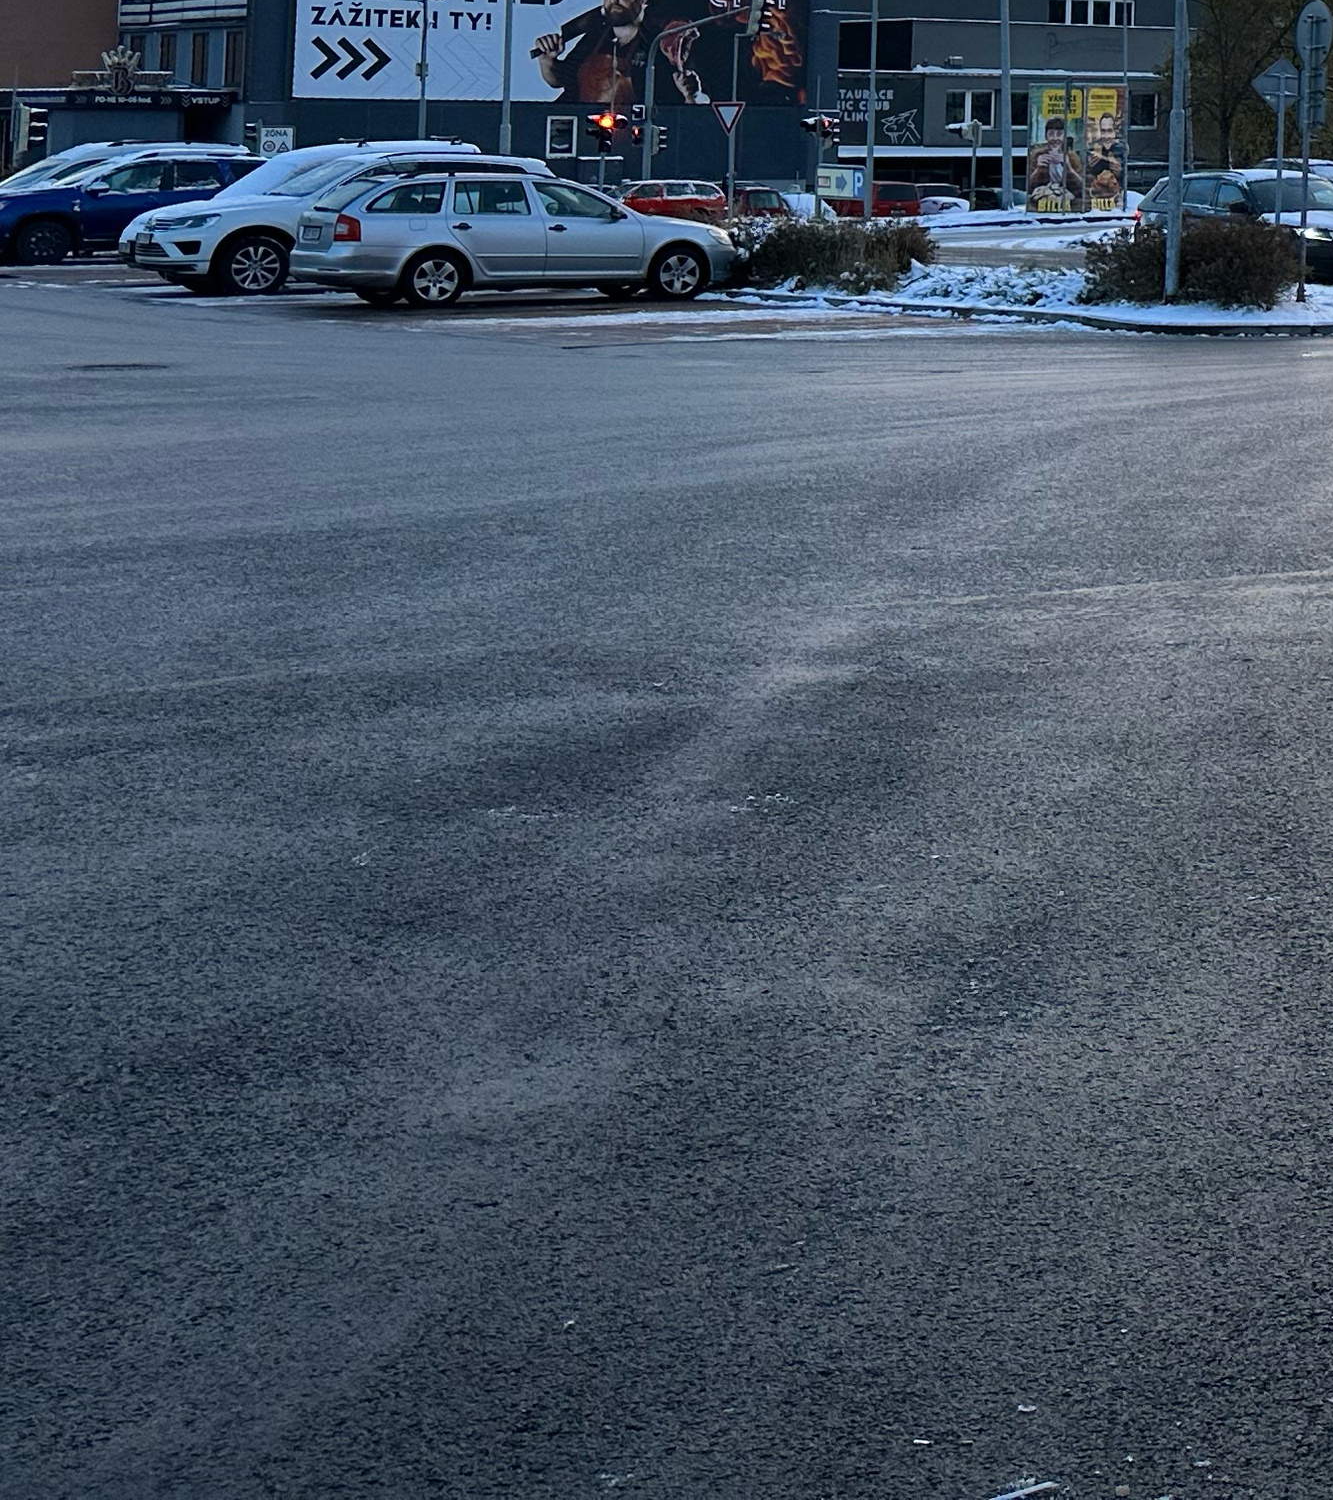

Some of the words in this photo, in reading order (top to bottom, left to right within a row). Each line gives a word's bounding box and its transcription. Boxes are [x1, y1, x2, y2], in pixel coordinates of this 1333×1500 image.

[311, 1, 421, 29] ZÁŽITEK
[449, 11, 492, 31] TY!
[859, 100, 890, 111] CUB
[854, 171, 864, 196] P
